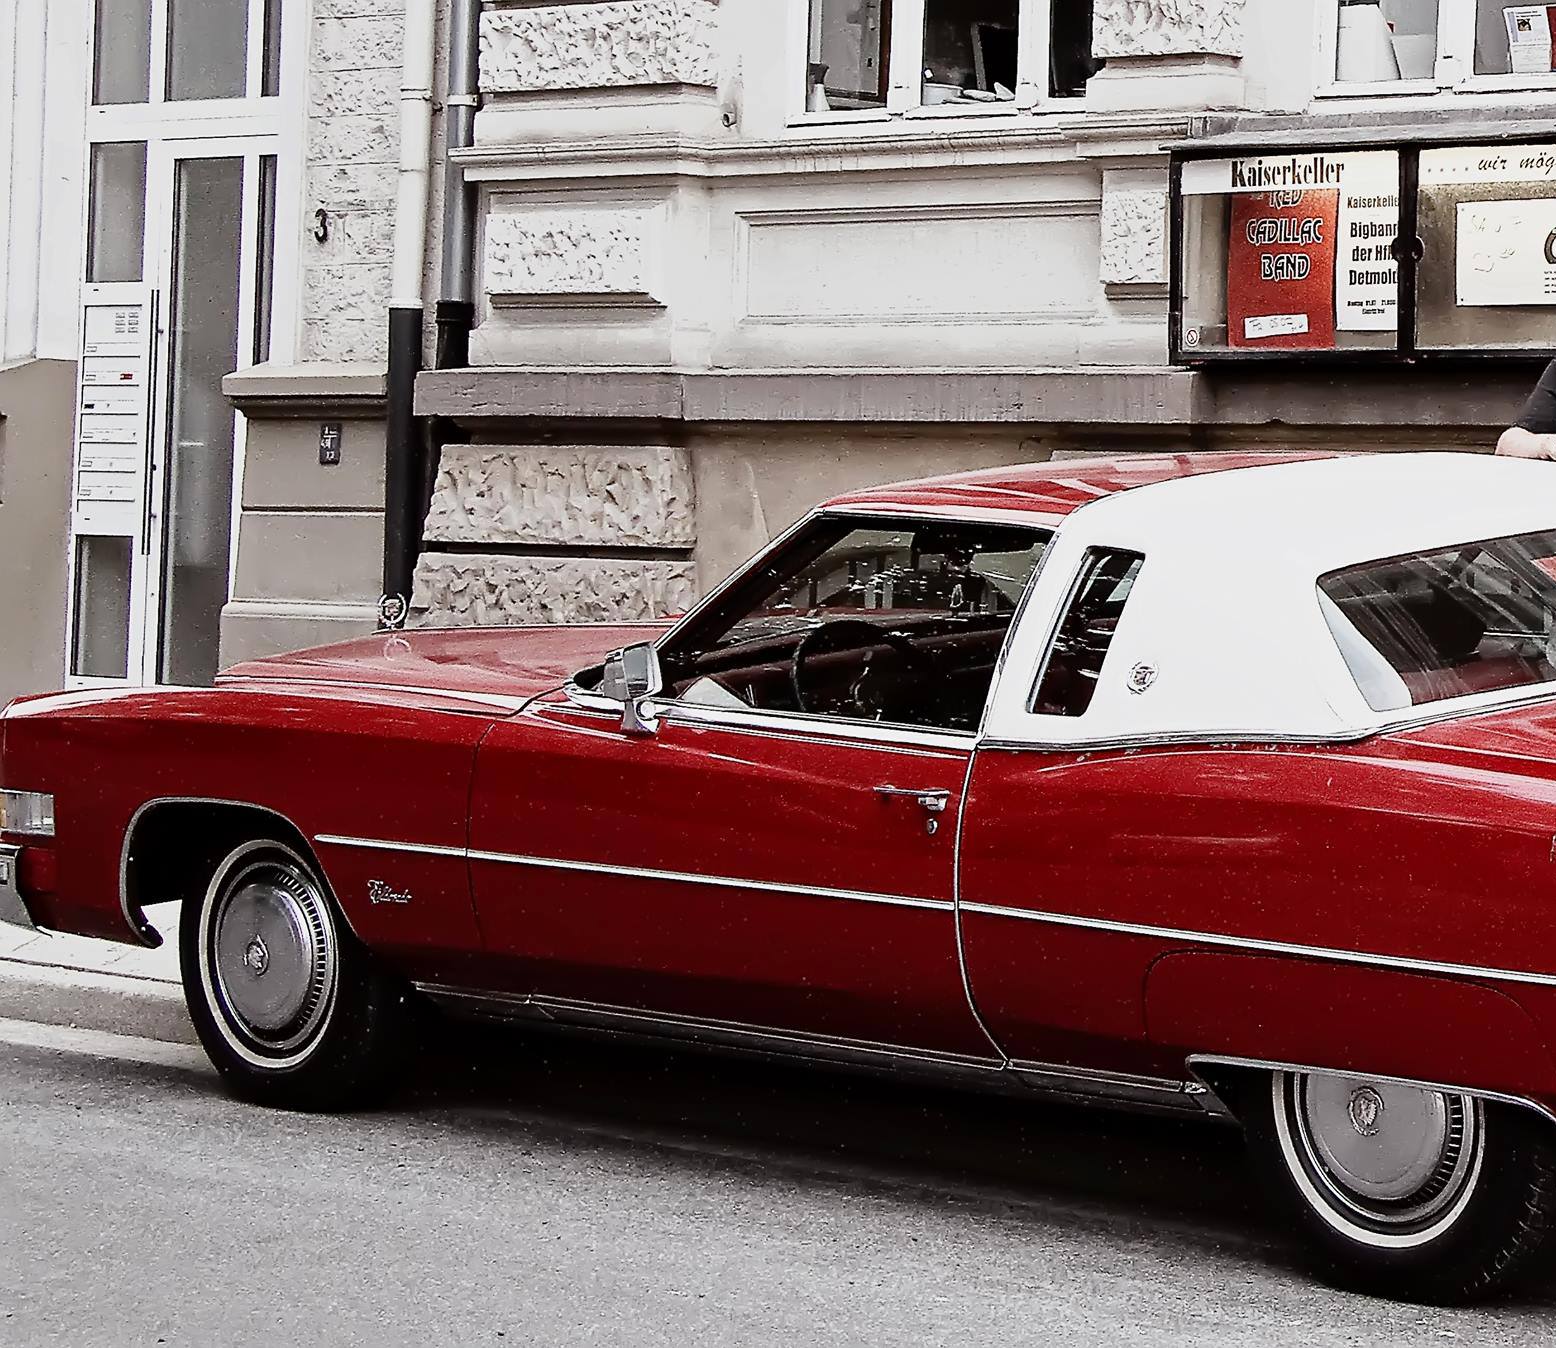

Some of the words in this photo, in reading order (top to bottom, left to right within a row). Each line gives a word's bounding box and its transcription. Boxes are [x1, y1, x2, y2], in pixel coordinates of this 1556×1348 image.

[1231, 157, 1345, 188] Kaiserkeller
[1477, 157, 1508, 171] wir
[1347, 195, 1399, 208] Kaiserkelle
[314, 208, 328, 243] 3
[1246, 217, 1323, 246] CADILLAC
[1260, 252, 1311, 282] BAND
[1352, 245, 1373, 262] der
